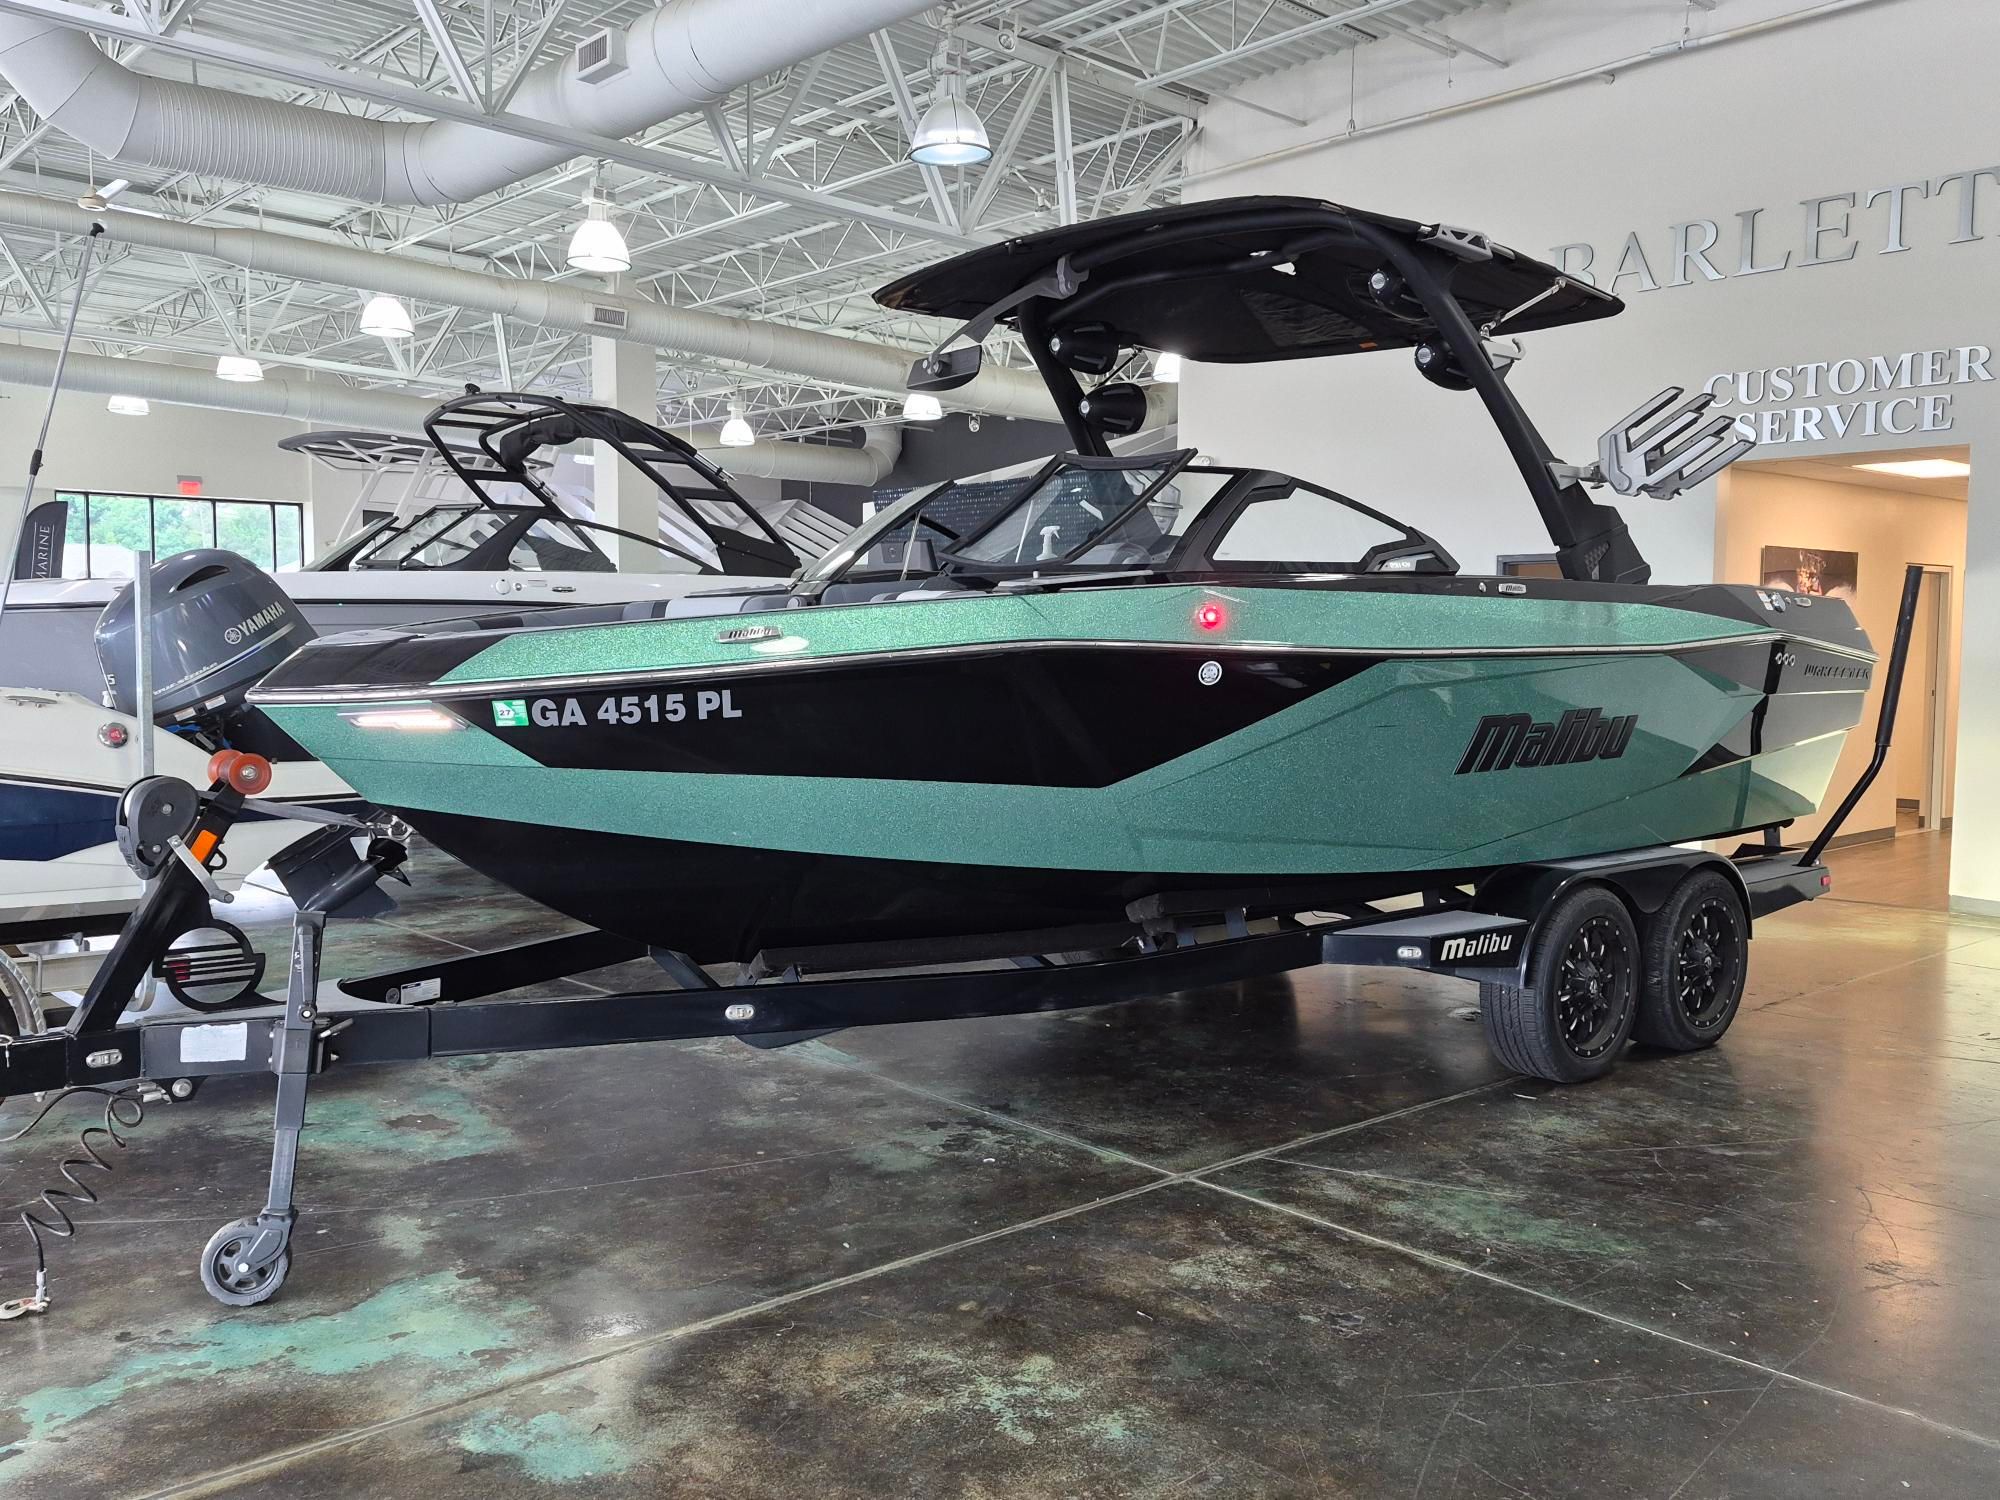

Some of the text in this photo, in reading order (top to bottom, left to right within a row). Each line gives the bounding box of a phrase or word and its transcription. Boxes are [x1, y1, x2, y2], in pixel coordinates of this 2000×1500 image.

[1549, 165, 2000, 296] BARLETT
[1703, 345, 1995, 408] CUSTOMER
[1733, 393, 1954, 446] SERVICE
[237, 601, 285, 636] YAMAHA
[531, 689, 743, 728] GA 4515 PL
[1453, 707, 1639, 775] Malibu
